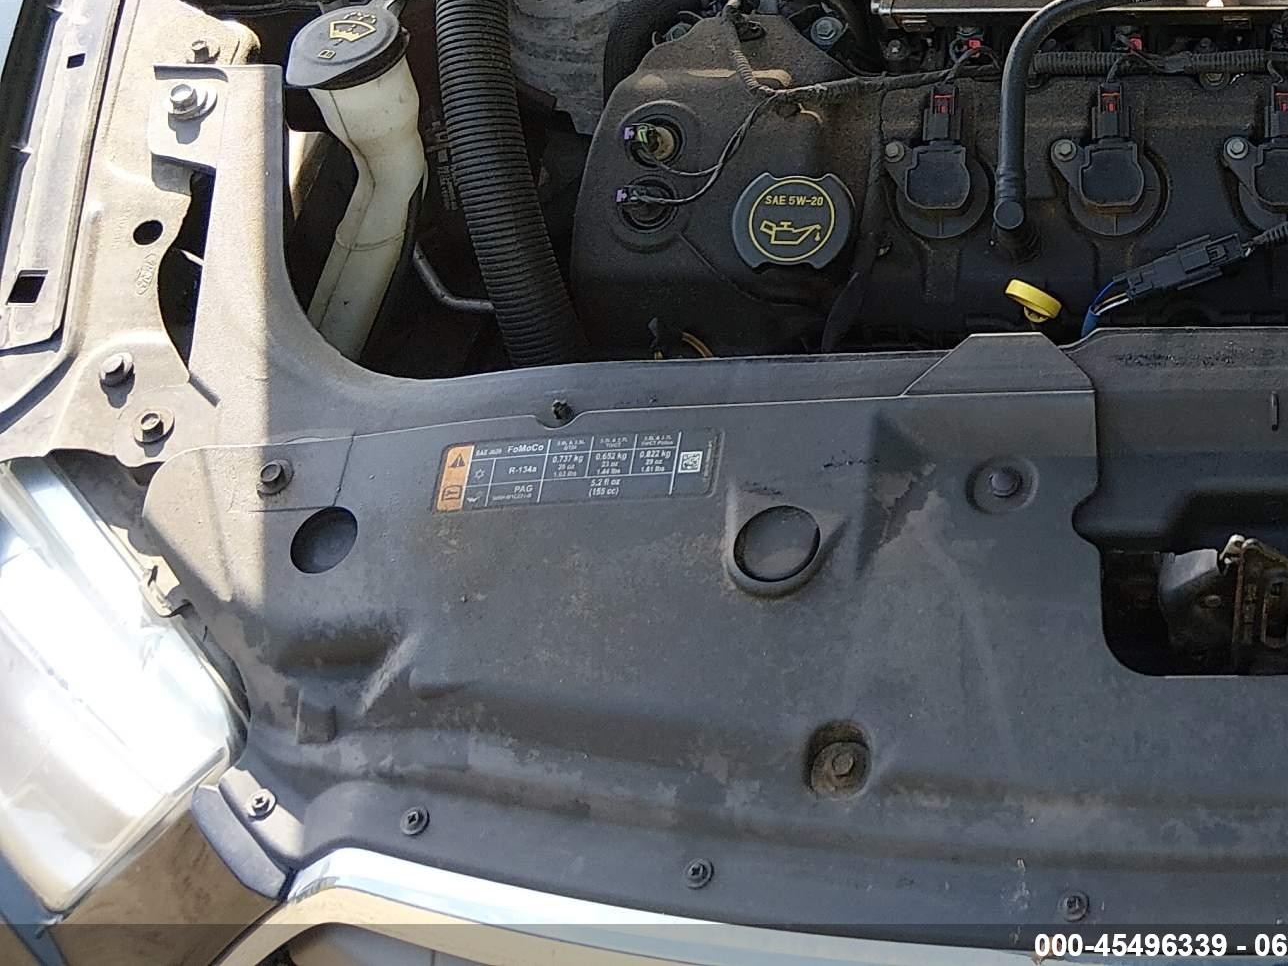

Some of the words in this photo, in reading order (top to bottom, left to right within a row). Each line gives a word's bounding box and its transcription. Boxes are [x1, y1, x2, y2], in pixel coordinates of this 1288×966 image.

[764, 195, 787, 205] SAE
[788, 196, 824, 206] 5W-20
[507, 444, 545, 454] FoMoCo
[552, 454, 573, 464] 0.737
[574, 454, 584, 464] kg
[595, 452, 616, 460] 0.652
[617, 452, 628, 461] kg
[639, 450, 660, 459] 0.822
[661, 450, 672, 459] kg
[508, 466, 537, 475] R-134a
[590, 478, 603, 486] 5.2
[610, 478, 621, 486] oz
[514, 485, 534, 494] PAG
[588, 488, 606, 497] (155
[606, 487, 620, 496] cc)
